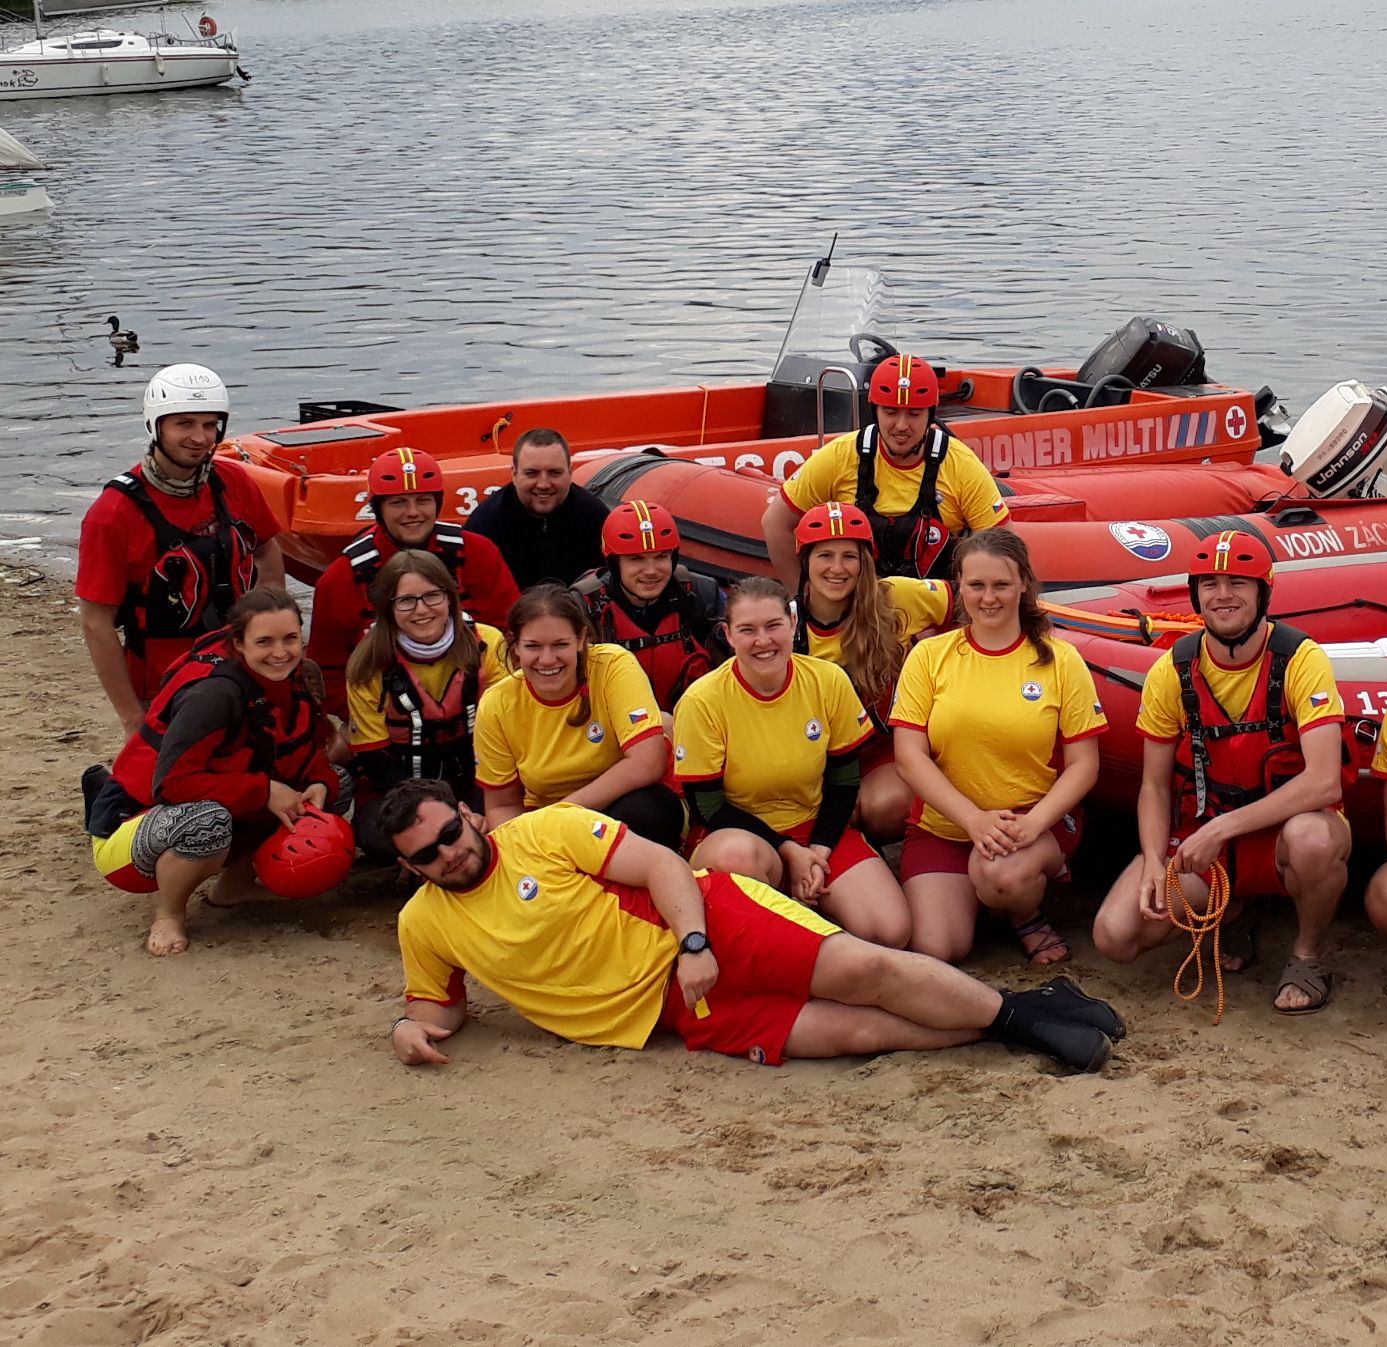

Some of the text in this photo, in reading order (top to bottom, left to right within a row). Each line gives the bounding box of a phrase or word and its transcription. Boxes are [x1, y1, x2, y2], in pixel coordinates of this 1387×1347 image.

[1139, 363, 1163, 389] ATSU
[1081, 415, 1163, 461] MULTI
[1316, 431, 1368, 485] Johnson
[1275, 524, 1345, 558] VODNÍ
